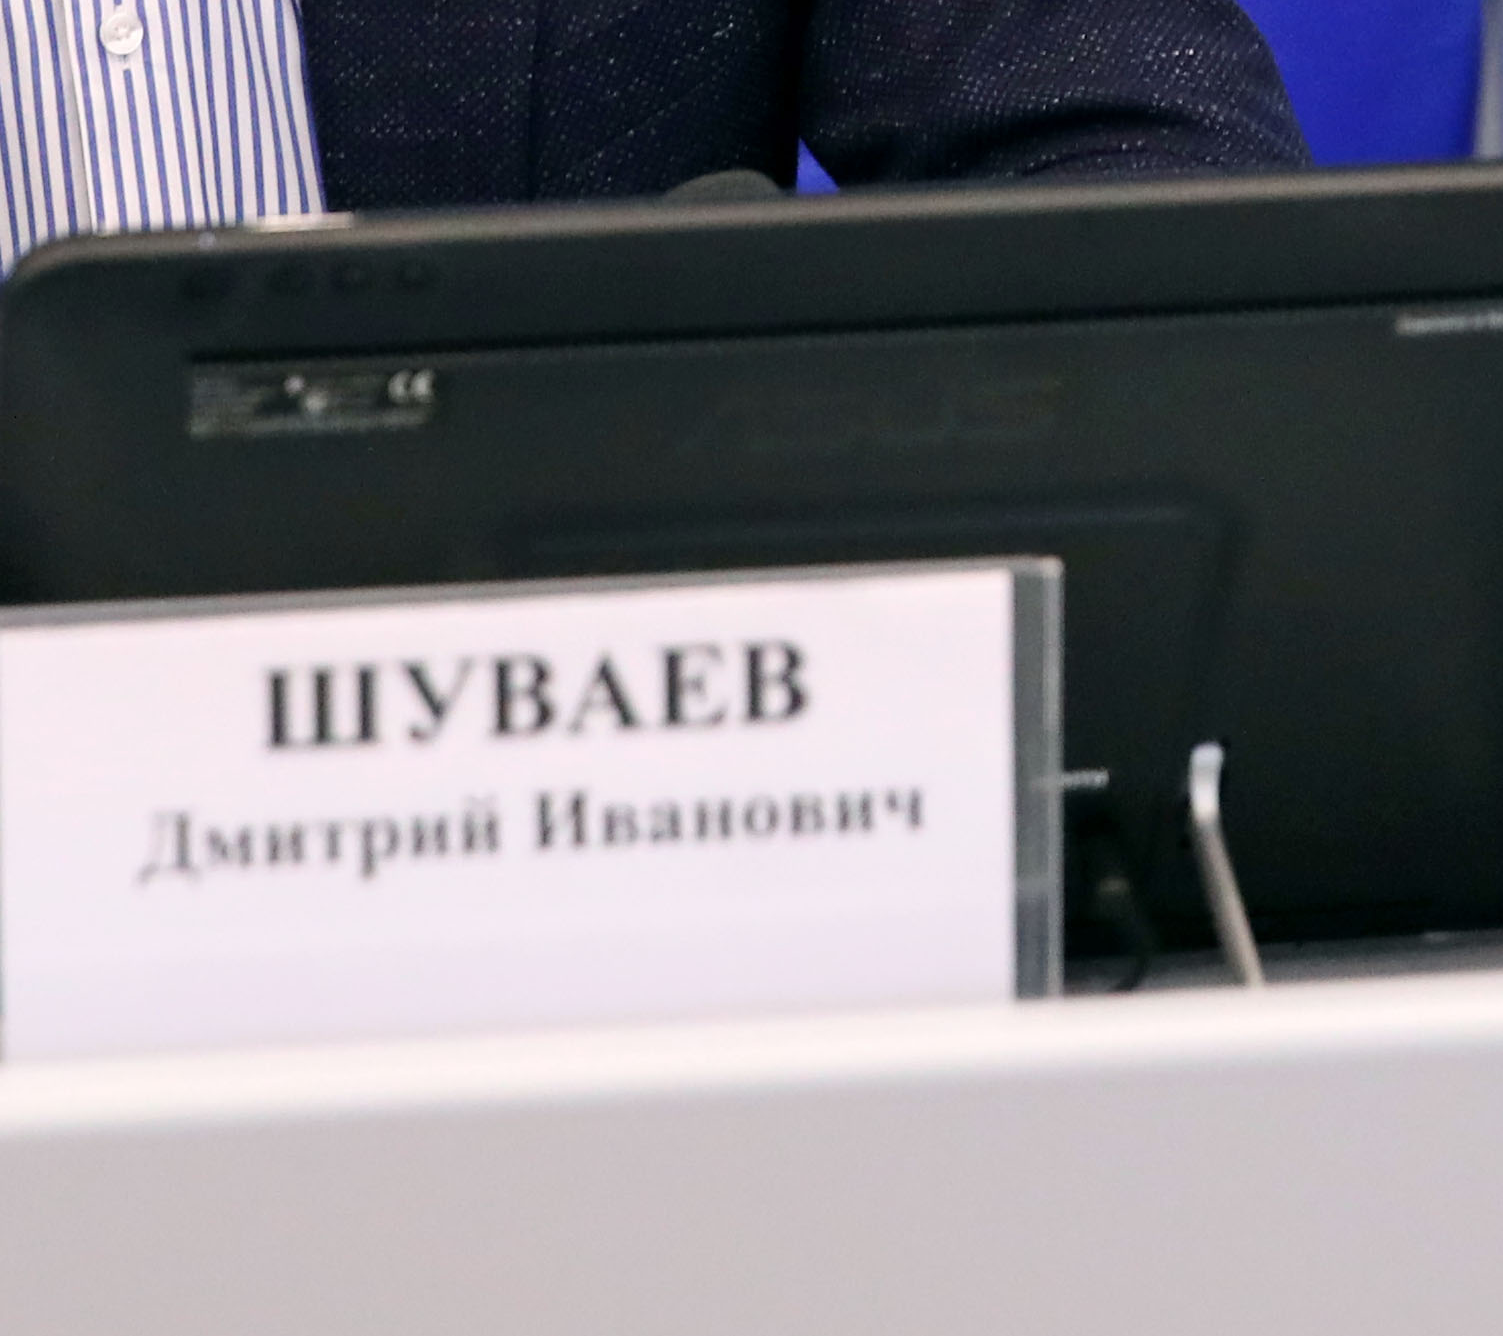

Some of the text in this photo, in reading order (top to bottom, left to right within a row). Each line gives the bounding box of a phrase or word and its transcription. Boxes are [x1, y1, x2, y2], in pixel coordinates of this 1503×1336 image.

[264, 638, 813, 753] ШУВАЕВ
[136, 785, 927, 883] Дмитрий Иванович
